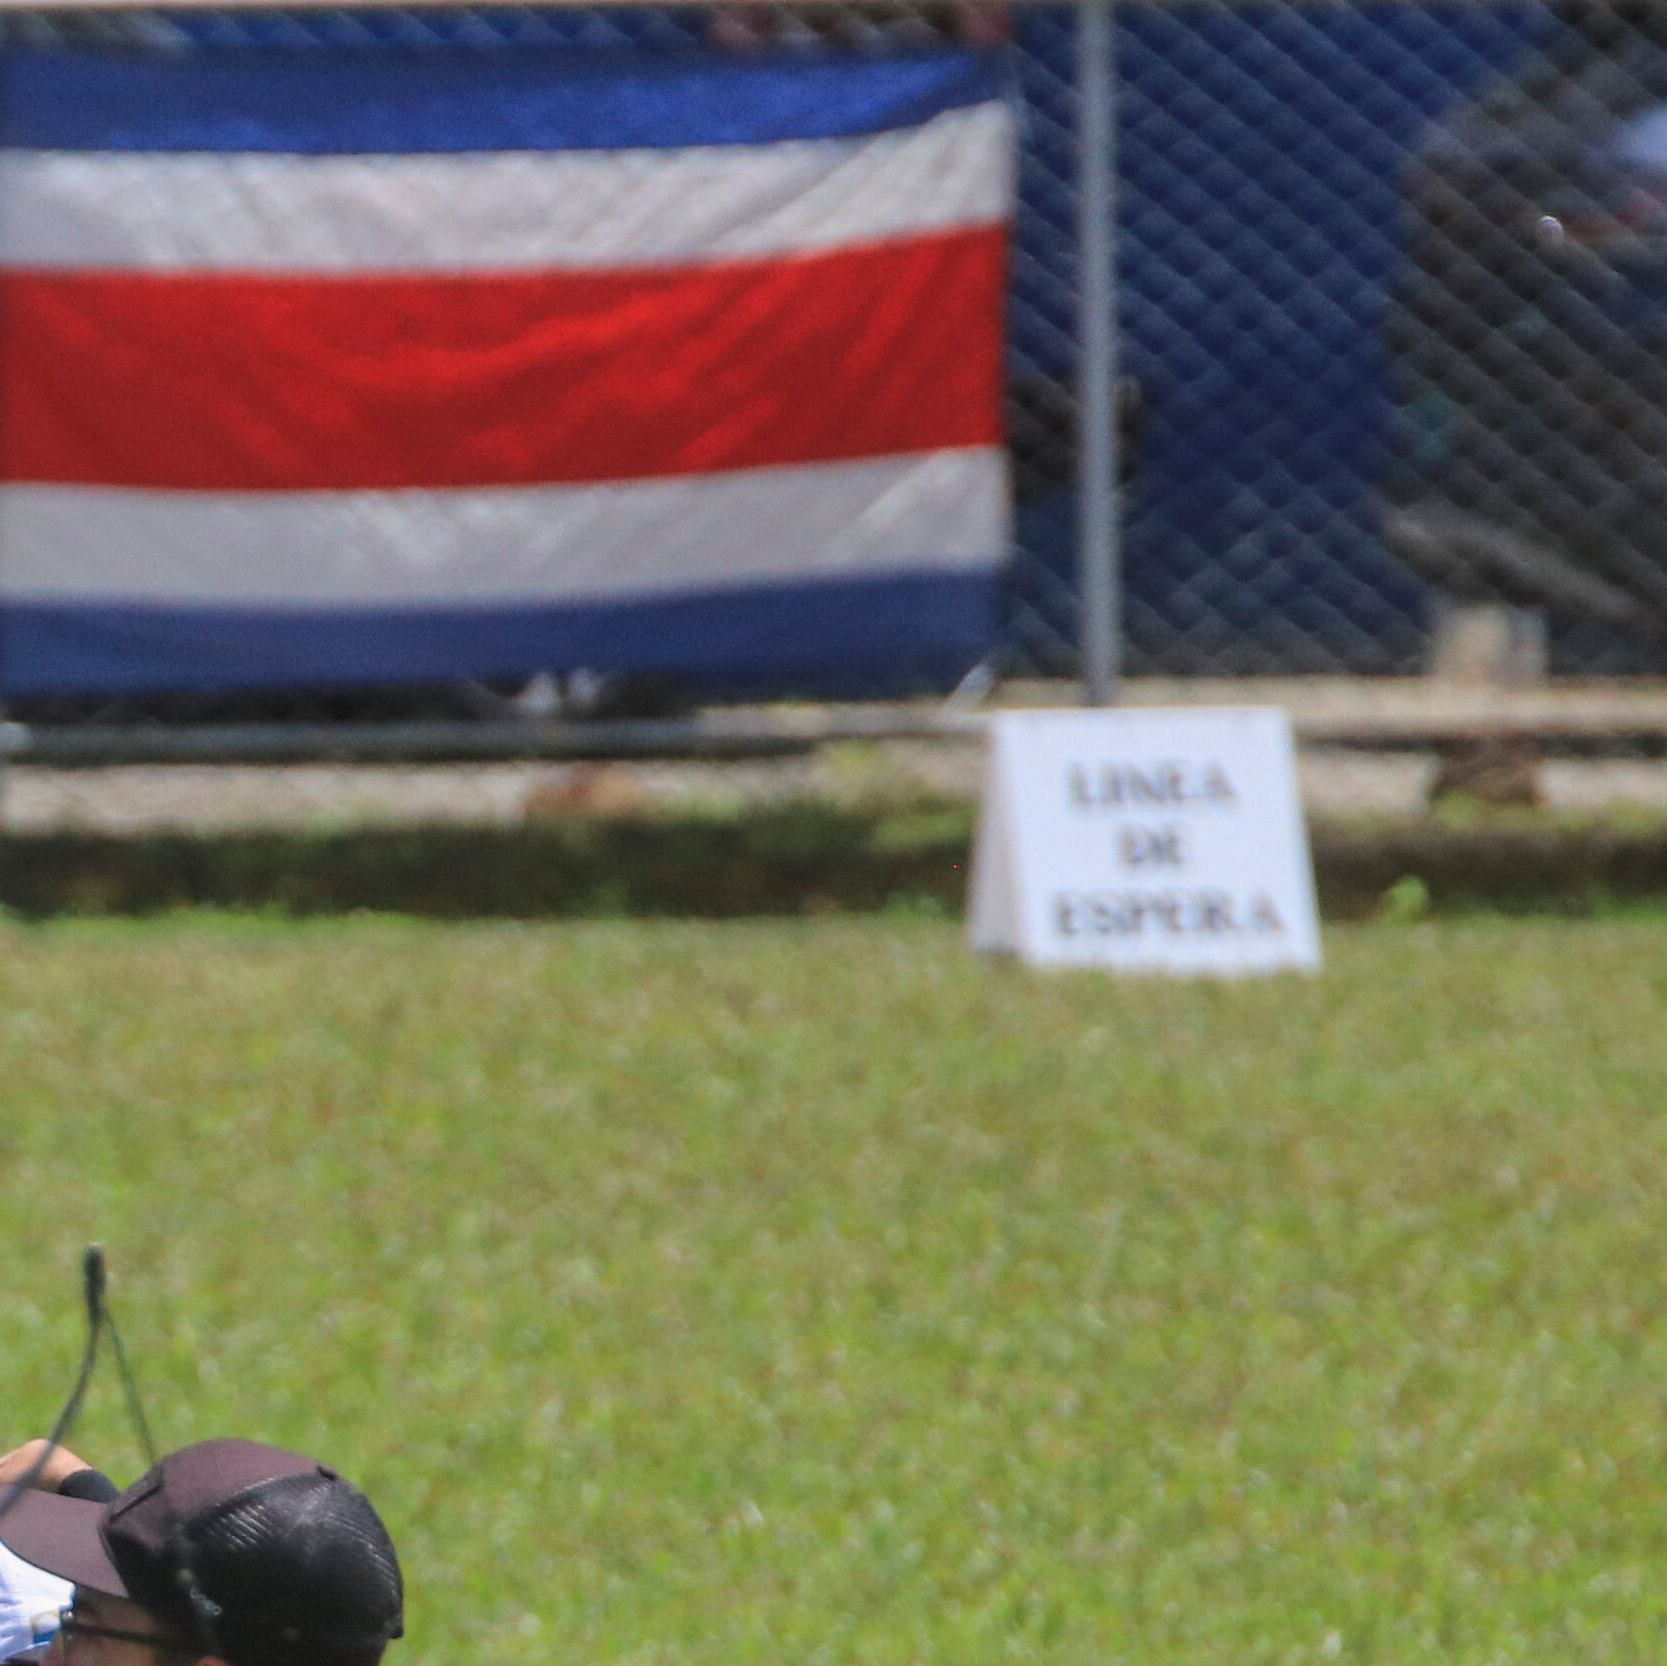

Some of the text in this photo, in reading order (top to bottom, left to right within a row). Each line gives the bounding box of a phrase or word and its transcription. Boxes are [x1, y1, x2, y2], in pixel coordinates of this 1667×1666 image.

[1067, 758, 1239, 808] LINEA
[1119, 824, 1185, 868] DE
[1053, 890, 1286, 938] ESPERA
